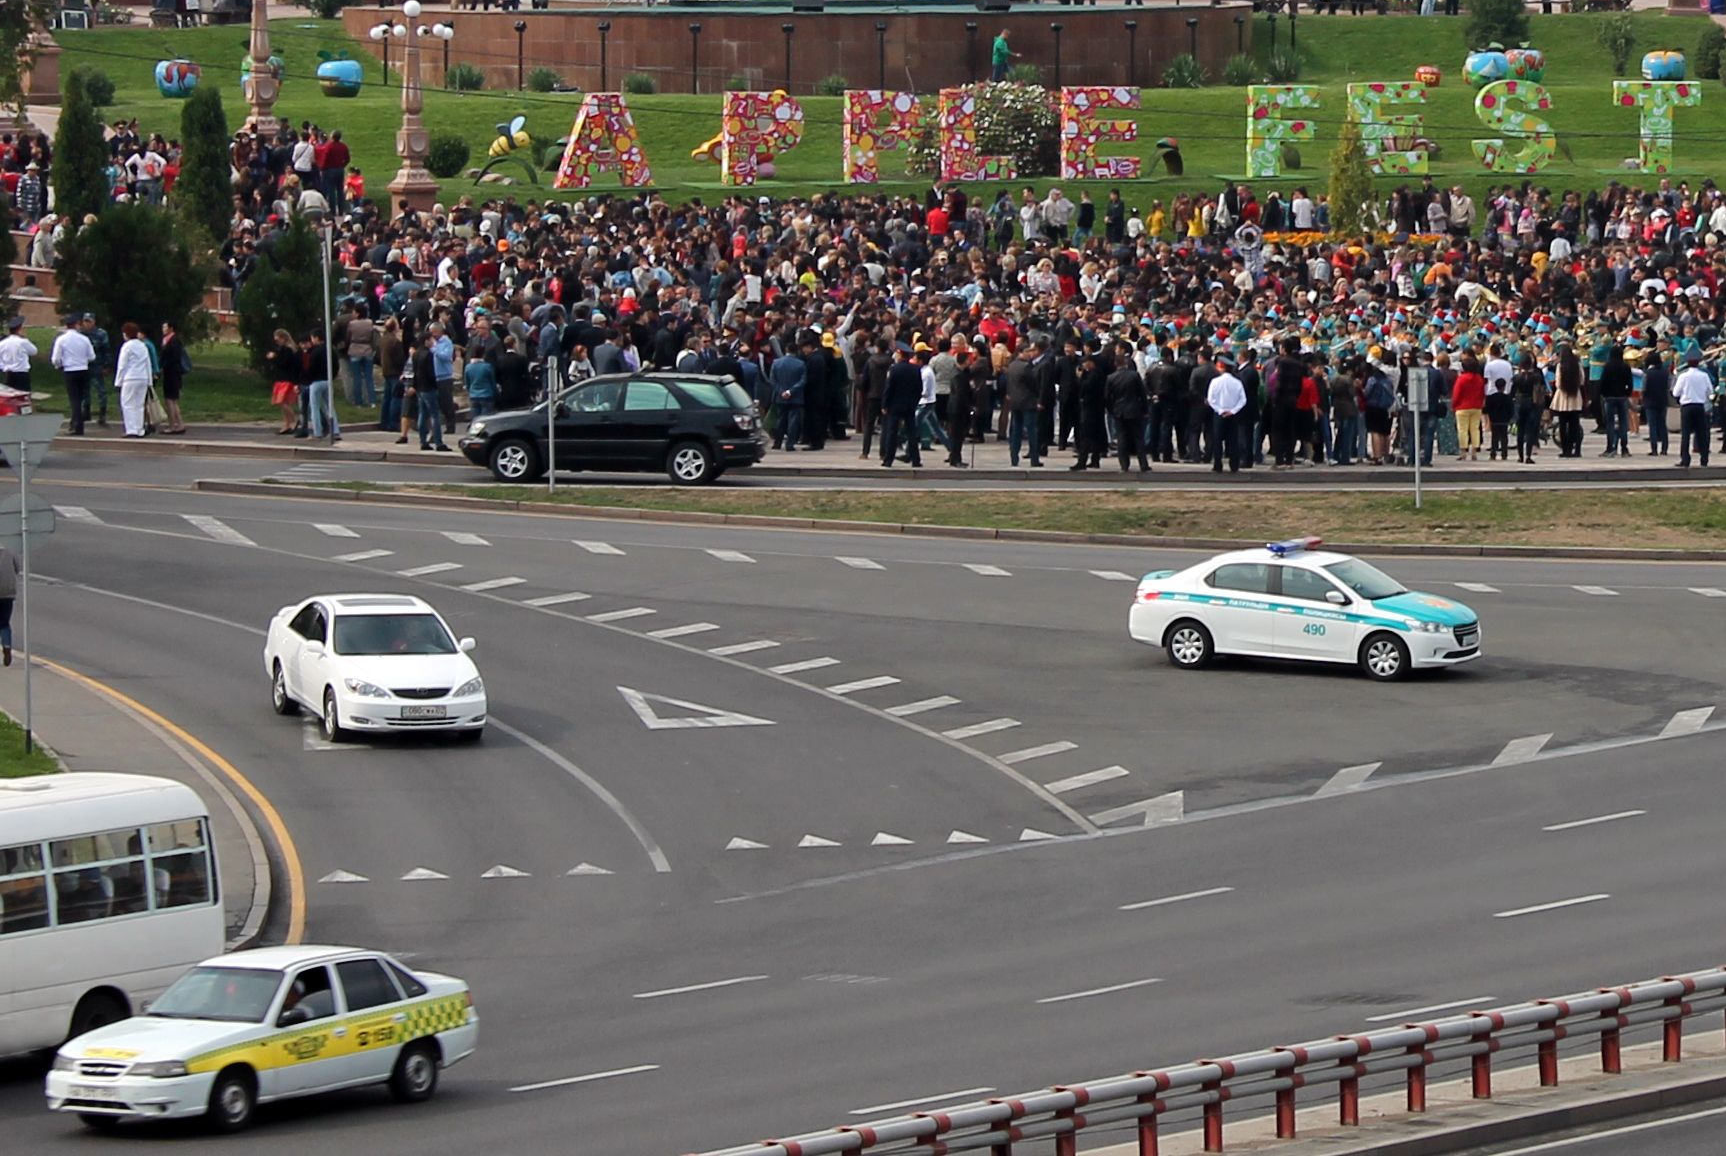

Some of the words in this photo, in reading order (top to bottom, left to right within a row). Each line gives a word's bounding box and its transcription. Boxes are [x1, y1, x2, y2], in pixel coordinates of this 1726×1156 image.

[551, 86, 1147, 189] APPLE
[1246, 80, 1702, 178] FEST
[1302, 623, 1326, 636] 490
